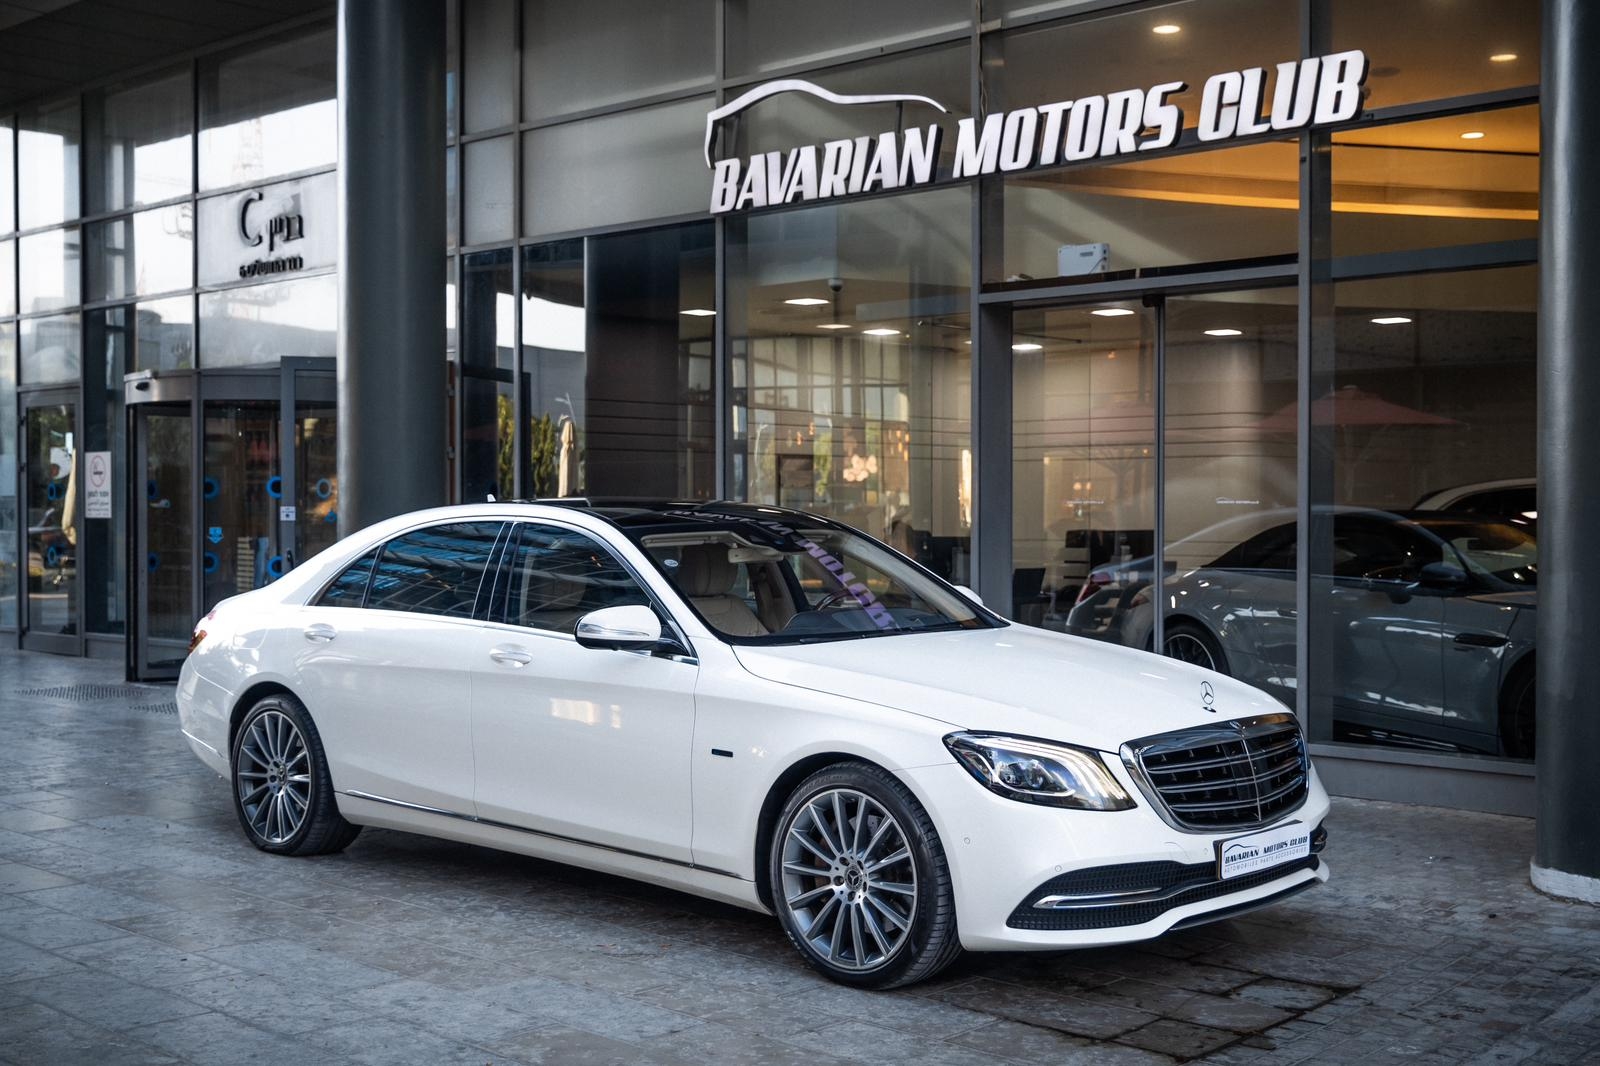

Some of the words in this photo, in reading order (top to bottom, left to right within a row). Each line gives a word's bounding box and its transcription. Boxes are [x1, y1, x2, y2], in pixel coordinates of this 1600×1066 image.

[710, 123, 940, 214] BAVARIAN
[953, 81, 1186, 179] MOTORS
[1198, 50, 1367, 142] CLUB
[1225, 848, 1260, 864] BAVARIAN
[1263, 840, 1288, 854] MOTORS
[1290, 836, 1308, 847] CLUB
